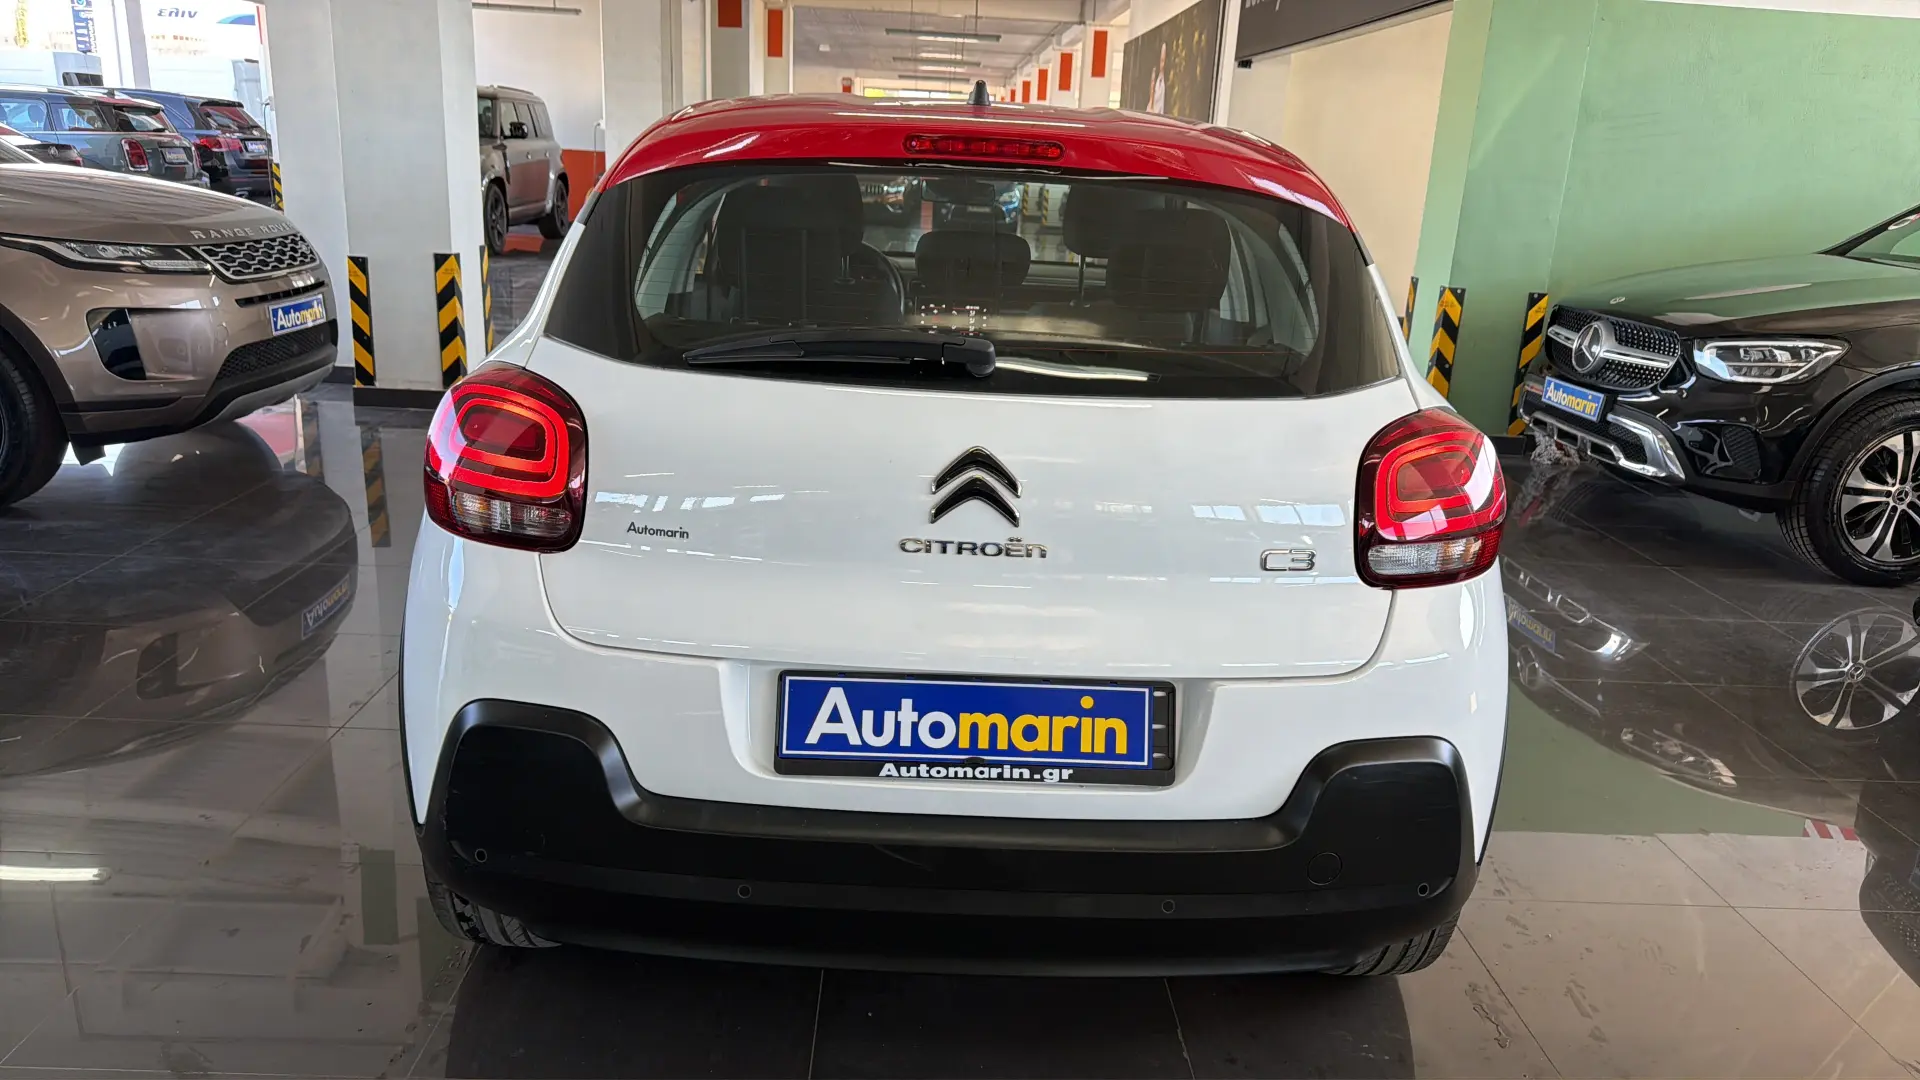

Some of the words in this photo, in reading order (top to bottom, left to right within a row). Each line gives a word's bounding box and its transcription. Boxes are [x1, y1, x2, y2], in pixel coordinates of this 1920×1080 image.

[190, 227, 255, 240] RANGE
[1545, 381, 1597, 416] Automarin
[626, 521, 690, 540] Automarin
[1260, 548, 1316, 571] C3
[804, 686, 1128, 755] Automarin
[878, 762, 1074, 782] Automarin.gr
